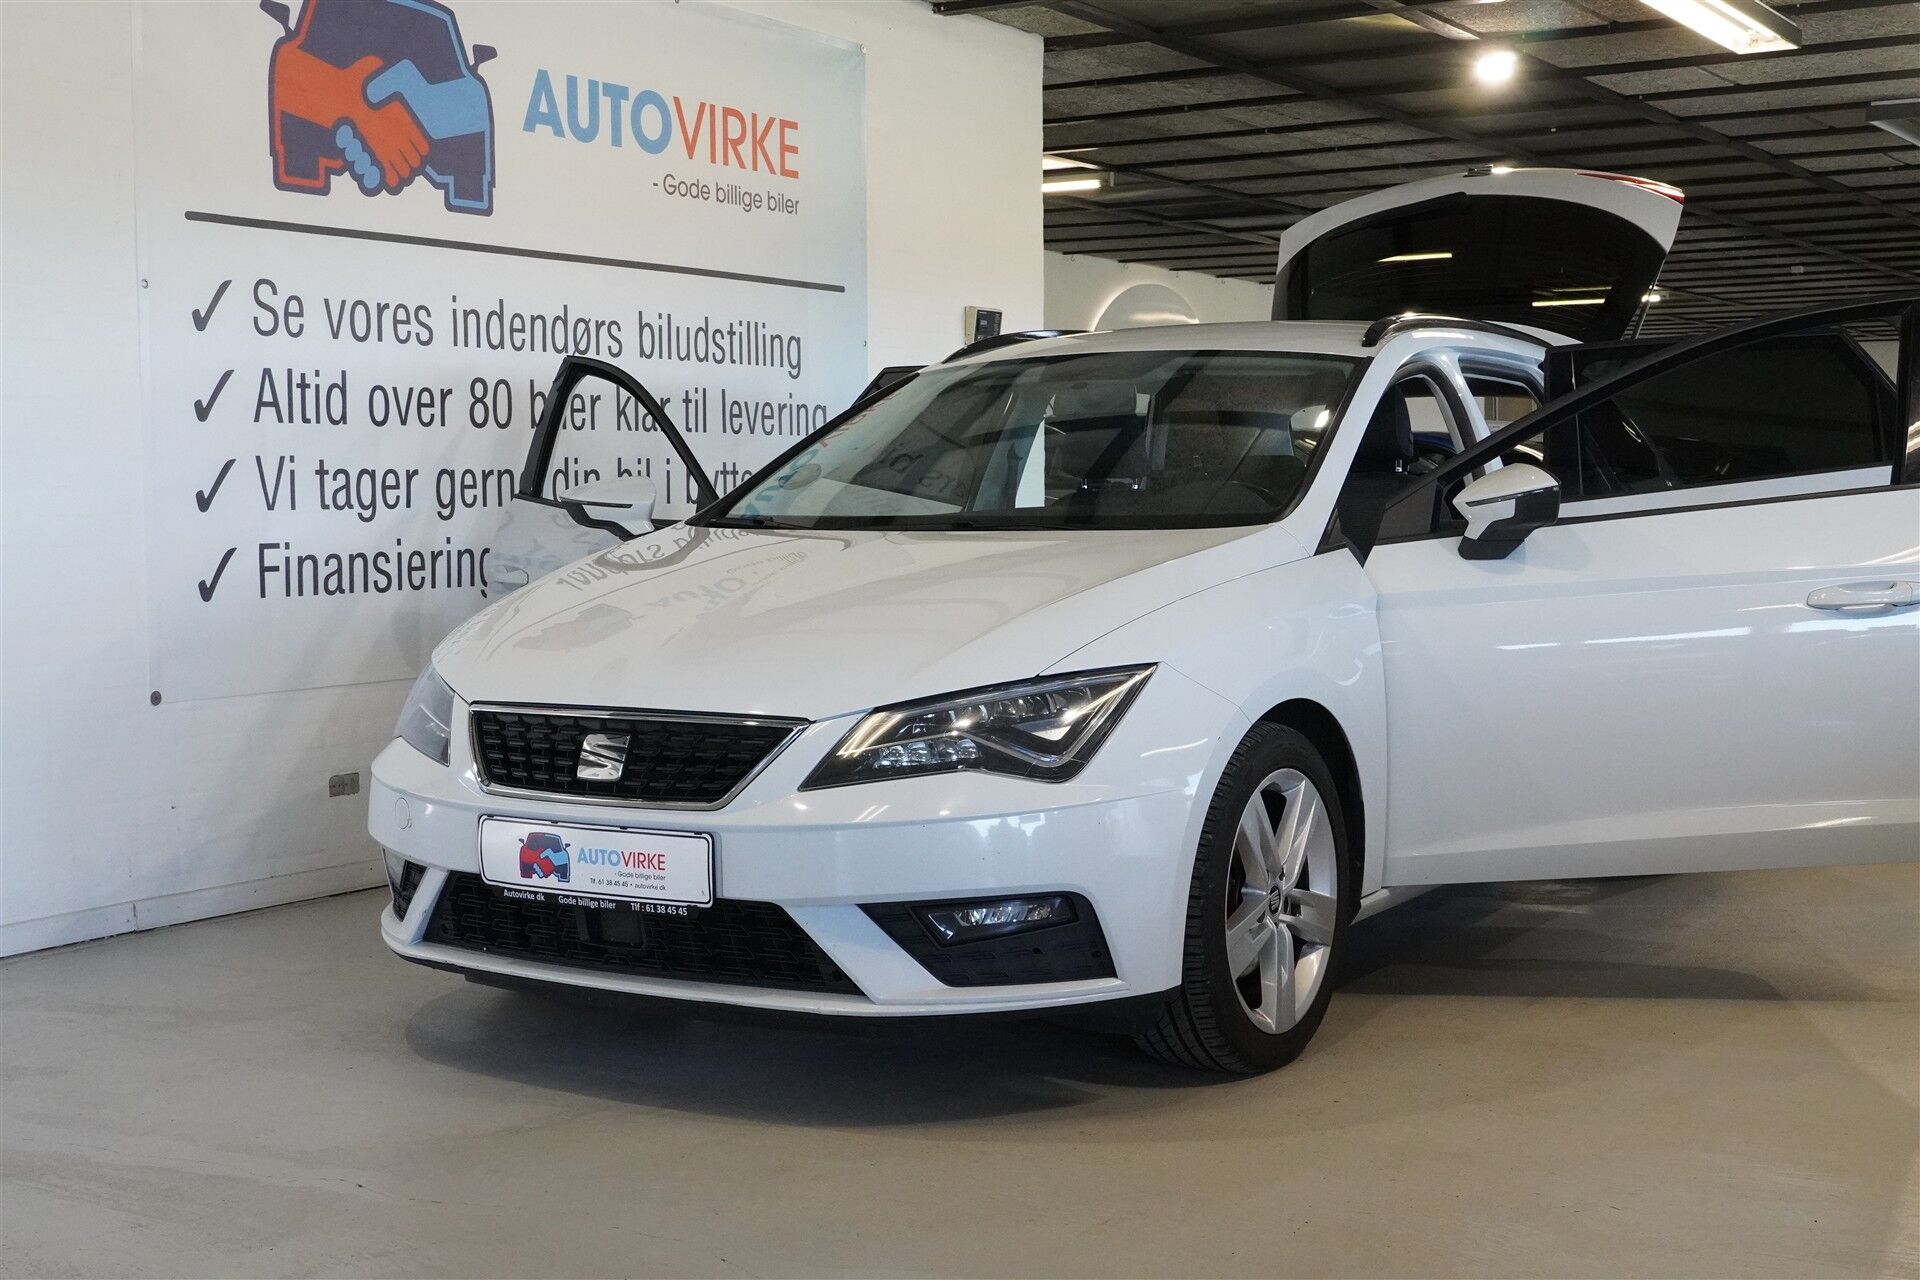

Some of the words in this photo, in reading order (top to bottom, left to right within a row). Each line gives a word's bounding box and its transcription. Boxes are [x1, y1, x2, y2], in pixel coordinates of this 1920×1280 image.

[522, 68, 799, 179] AUTOVIRKE
[662, 173, 711, 201] Gode
[715, 181, 763, 213] billige
[767, 190, 800, 216] biler
[252, 278, 305, 339] Se
[323, 297, 434, 347] vores
[452, 295, 622, 358] indendørs
[638, 310, 801, 380] biludstilling
[253, 367, 348, 426] Altid
[368, 384, 453, 428] over
[469, 376, 513, 430] 80
[529, 378, 601, 431] ber
[682, 387, 707, 434] til
[255, 455, 297, 511] Vi
[315, 459, 419, 523] tager
[435, 467, 516, 521] gern
[666, 457, 671, 505] i
[577, 847, 666, 871] AUTOVIRKE
[503, 889, 535, 900] Autovirke
[558, 895, 577, 905] Gode
[577, 897, 599, 908] billige
[600, 900, 616, 909] biler
[645, 904, 655, 913] 61
[656, 905, 666, 914] 38
[667, 906, 677, 915] 45
[677, 907, 688, 916] 45
